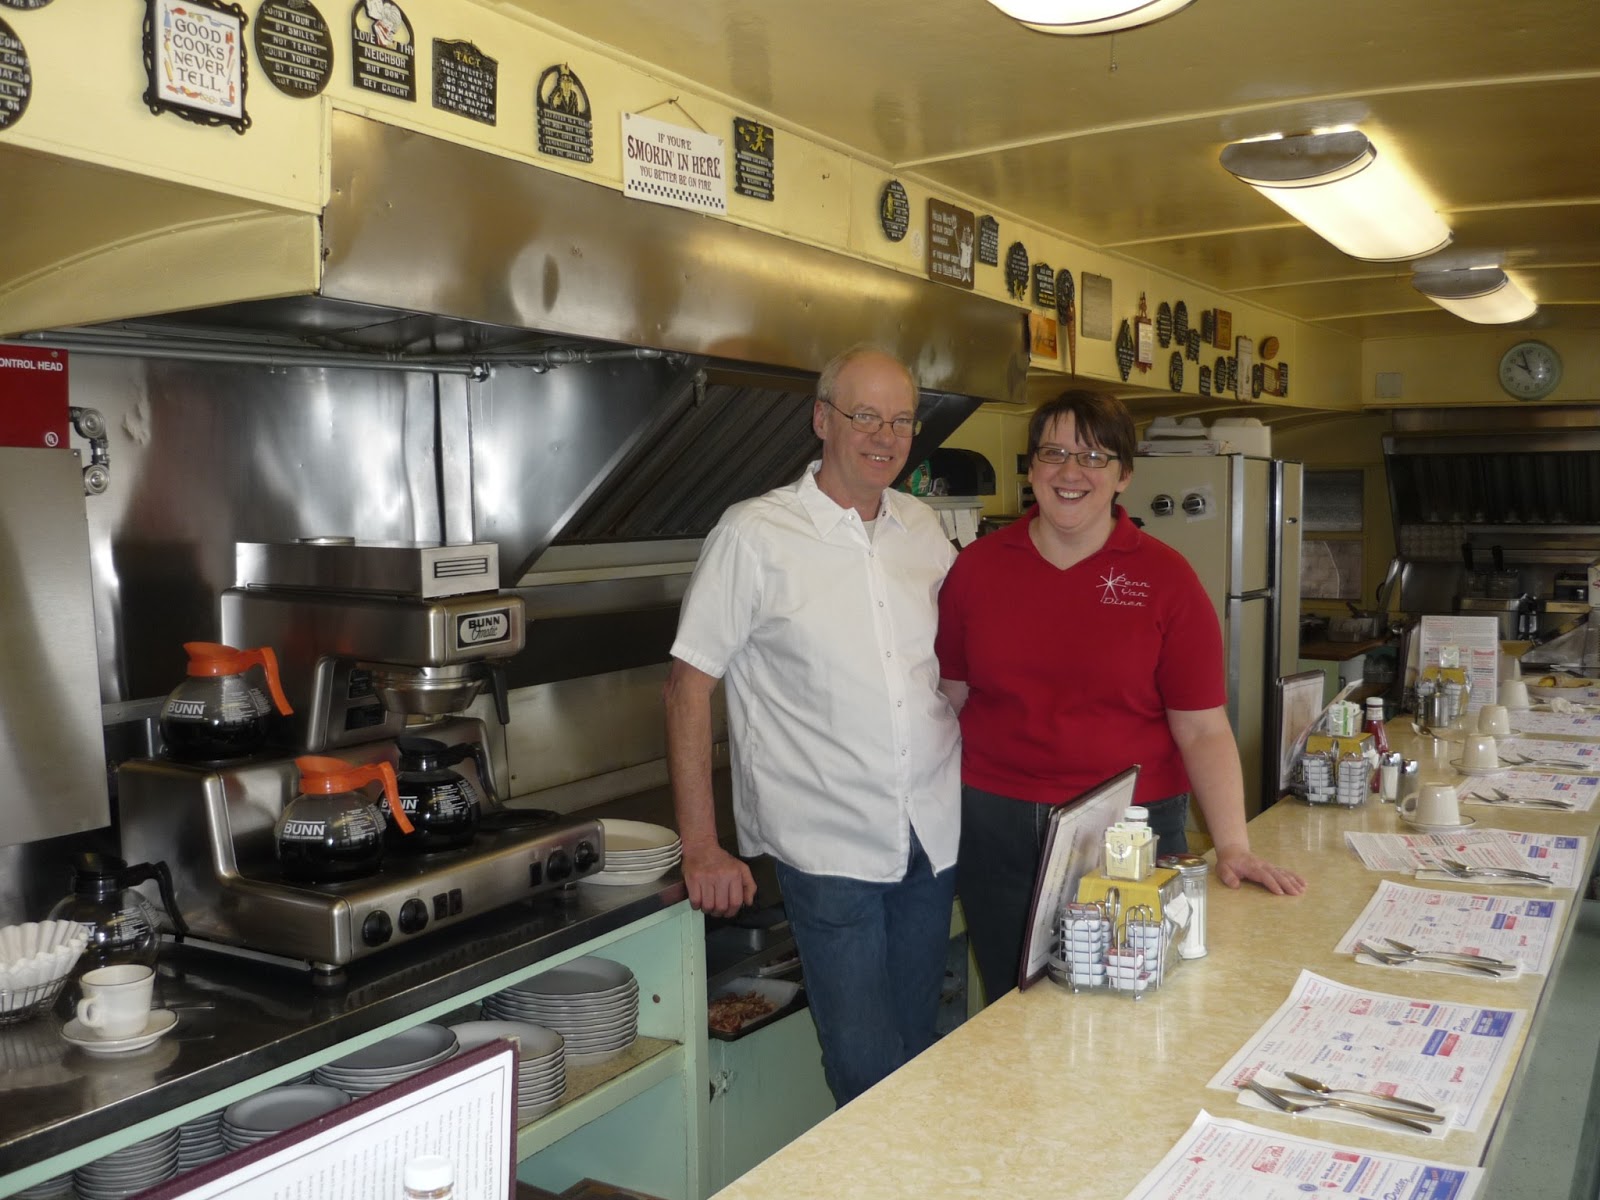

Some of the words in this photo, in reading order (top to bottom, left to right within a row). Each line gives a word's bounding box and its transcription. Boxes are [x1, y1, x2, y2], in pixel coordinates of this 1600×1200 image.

[275, 23, 285, 32] BY
[291, 14, 310, 26] YOUR
[175, 18, 221, 44] GOOD
[173, 34, 225, 61] COOKS
[273, 36, 287, 47] NOT
[354, 29, 376, 45] LOVE
[400, 43, 414, 56] THY
[174, 49, 226, 78] NEVER
[291, 54, 311, 66] YOUR
[364, 47, 406, 69] NEIGHBOR
[453, 49, 481, 67] TACT
[275, 63, 284, 72] BY
[366, 63, 380, 74] BUT
[384, 69, 405, 81] DON'T
[441, 58, 455, 69] THE
[457, 64, 483, 79] ABILITY
[275, 77, 289, 86] NOT
[442, 66, 458, 78] TELL
[468, 76, 482, 86] MAN
[363, 78, 377, 89] GET
[381, 83, 408, 98] CAUGHT
[442, 83, 456, 92] AND
[458, 88, 478, 99] MAKE
[658, 132, 666, 144] IF
[677, 152, 689, 172] IN
[691, 155, 721, 179] HERE
[640, 165, 653, 178] YOU
[653, 168, 678, 184] BETTER
[678, 174, 687, 186] BE
[688, 176, 697, 188] ON
[698, 178, 712, 191] FIRE
[0, 357, 37, 370] ONTROL
[37, 361, 64, 372] HEAD
[468, 615, 501, 630] BUNN
[167, 701, 206, 715] BUNN
[381, 798, 418, 810] BNN
[283, 822, 325, 836] BUNN
